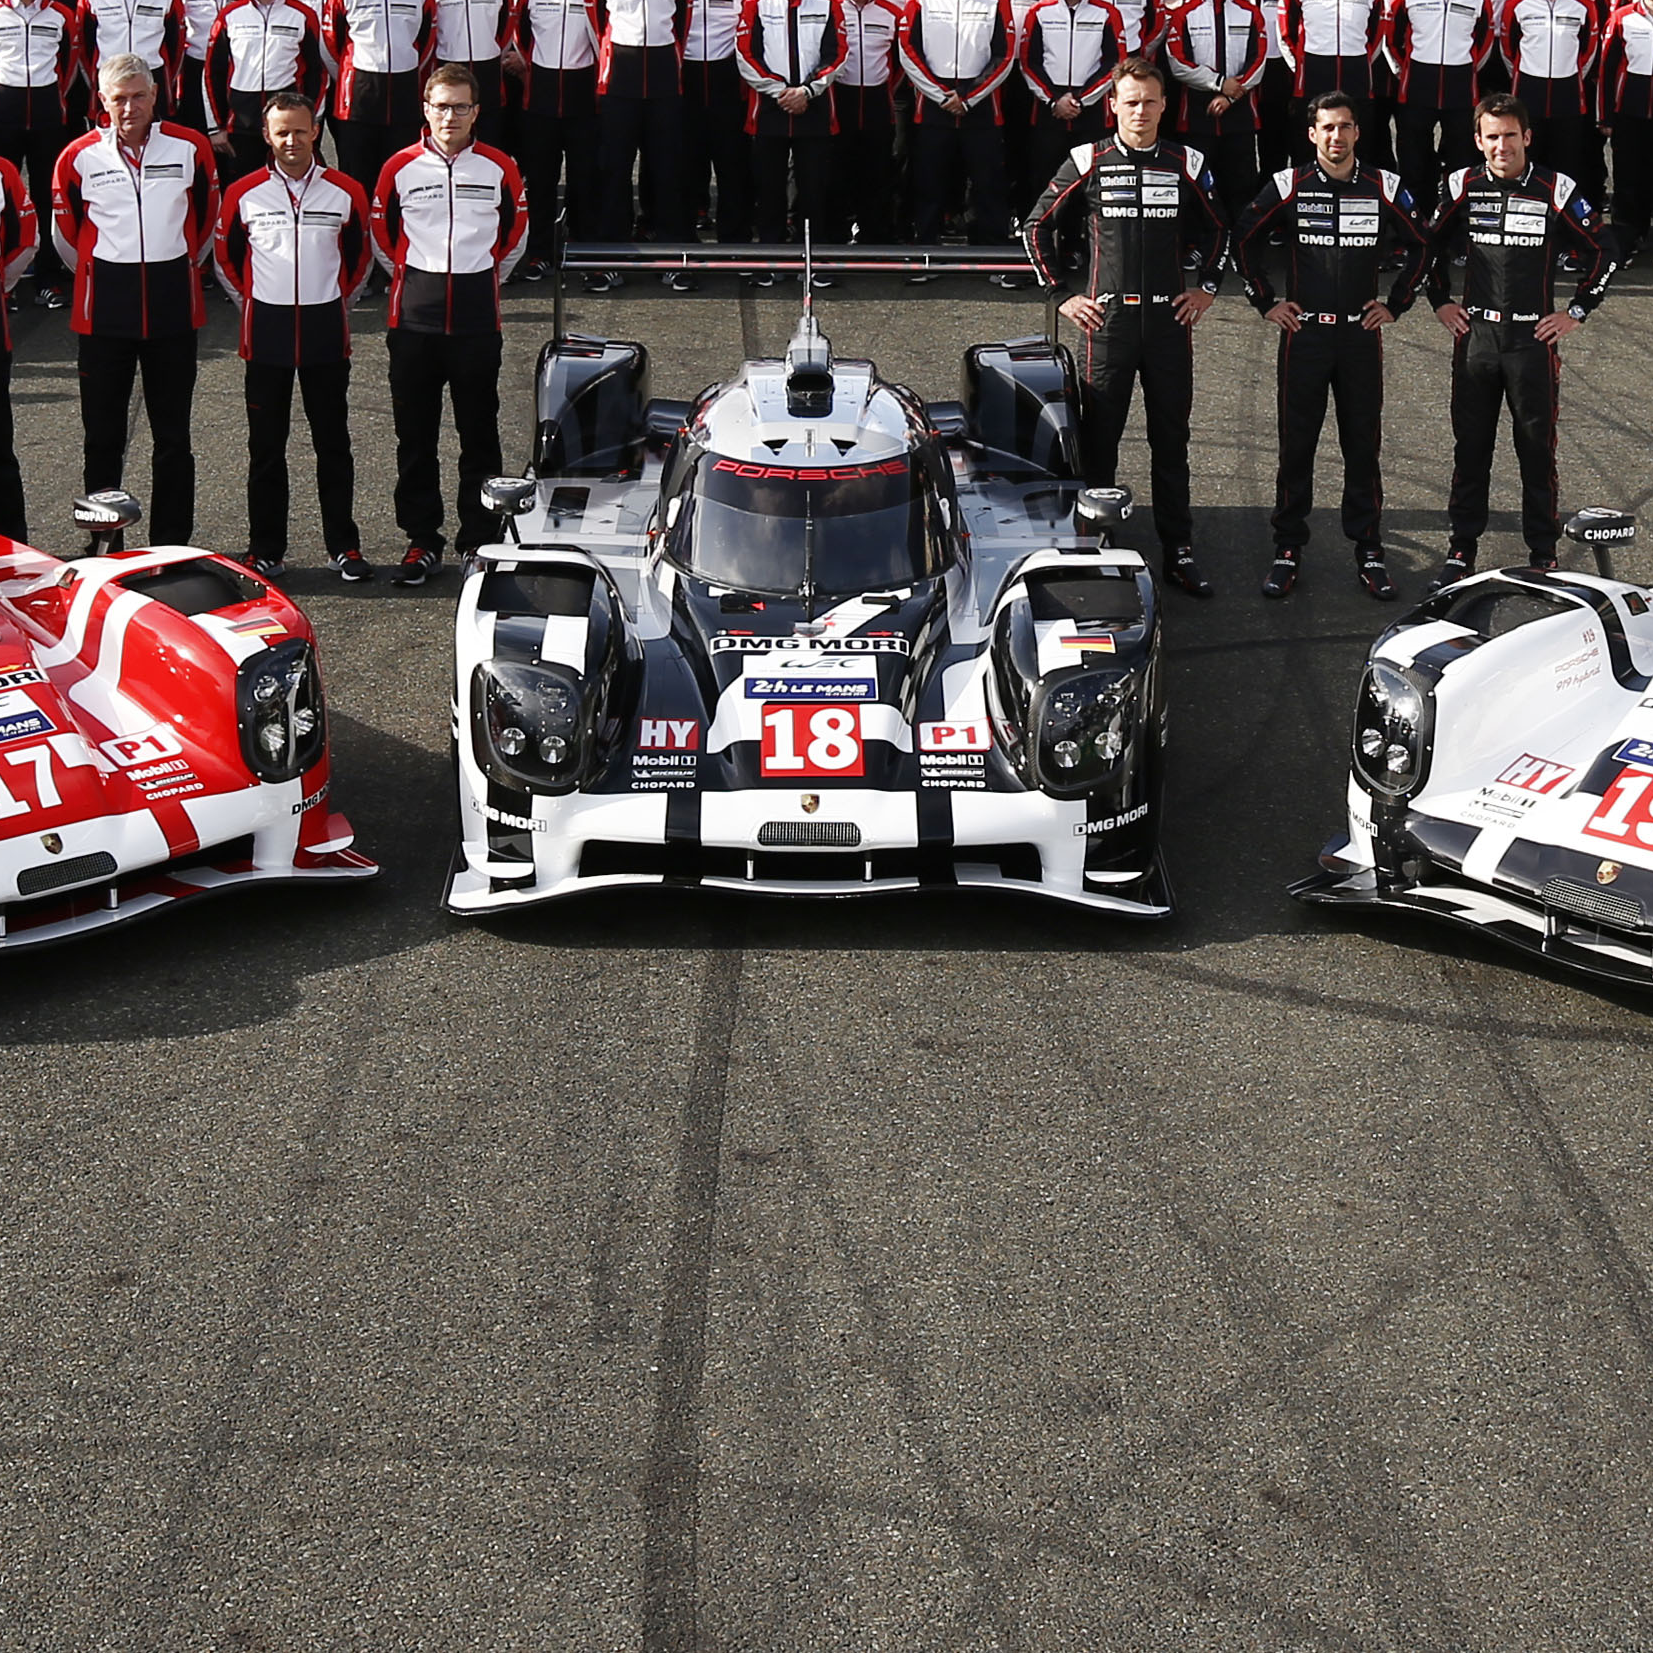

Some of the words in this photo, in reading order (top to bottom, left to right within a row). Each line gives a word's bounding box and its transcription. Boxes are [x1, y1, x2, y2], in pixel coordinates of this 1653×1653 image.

[1102, 207, 1138, 217] DMG
[1143, 208, 1178, 218] MORI
[1299, 234, 1335, 246] DMG
[1339, 236, 1378, 246] MORI
[1504, 235, 1543, 246] MORI
[712, 459, 909, 481] PORSCHE
[1583, 527, 1634, 541] CHOPARD
[1583, 628, 1596, 645] #19
[714, 638, 804, 653] DMG
[809, 638, 908, 654] MORI
[1554, 648, 1599, 674] PORSCHE
[1573, 664, 1601, 689] hybrid
[791, 684, 814, 694] LE
[815, 683, 868, 694] MANS
[639, 719, 697, 747] HY
[764, 708, 859, 770] 18
[932, 726, 978, 745] P1
[115, 737, 170, 760] P1
[632, 754, 680, 766] Mobil
[919, 754, 967, 766] Mobil
[126, 762, 171, 781] Mobil
[652, 769, 696, 778] MICHELIN
[941, 768, 985, 777] MICHELIN
[1506, 760, 1570, 793] HY
[146, 782, 204, 801] CHOPARD
[631, 781, 696, 789] CHOPARD
[921, 779, 987, 788] CHOPARD
[1478, 787, 1522, 806] Mobil
[471, 797, 499, 821] DMG
[501, 812, 546, 832] MORI
[1072, 819, 1112, 838] DMG
[1113, 803, 1149, 832] MORI
[1460, 811, 1516, 829] CHOPARD
